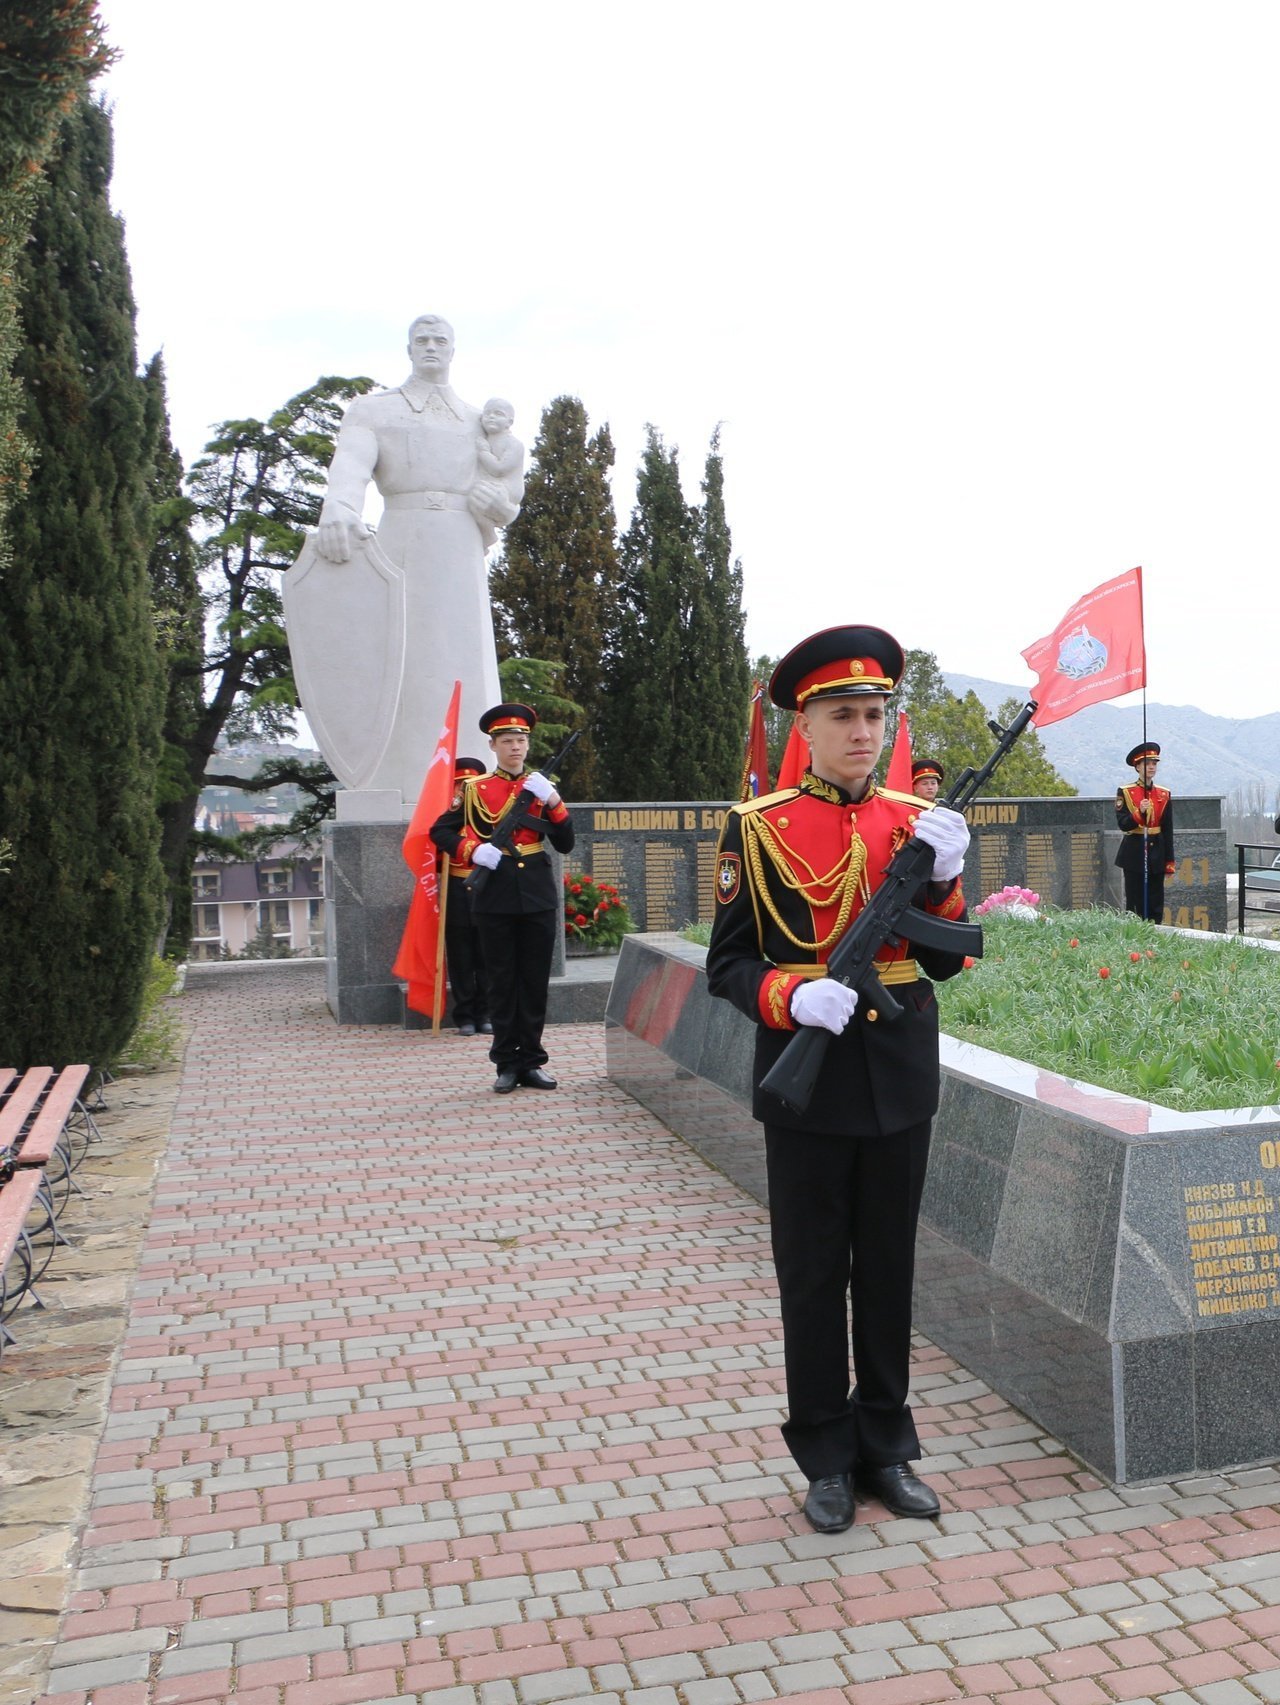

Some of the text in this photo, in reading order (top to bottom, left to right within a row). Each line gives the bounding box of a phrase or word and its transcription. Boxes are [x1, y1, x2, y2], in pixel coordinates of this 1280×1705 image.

[594, 810, 679, 831] ПАВШИМ
[684, 810, 697, 830] В
[963, 805, 1019, 827] ОДИНУ
[1184, 1185, 1235, 1202] КНЯЗЕВ
[1247, 1218, 1255, 1234] Е
[1256, 1216, 1267, 1233] Я
[1190, 1236, 1277, 1259] ЛИТВИНЕНКО
[1194, 1257, 1254, 1277] ЛОБАЧЕВ
[1260, 1254, 1270, 1270] В
[1195, 1274, 1277, 1296] МЕРЗЛЯКОВ
